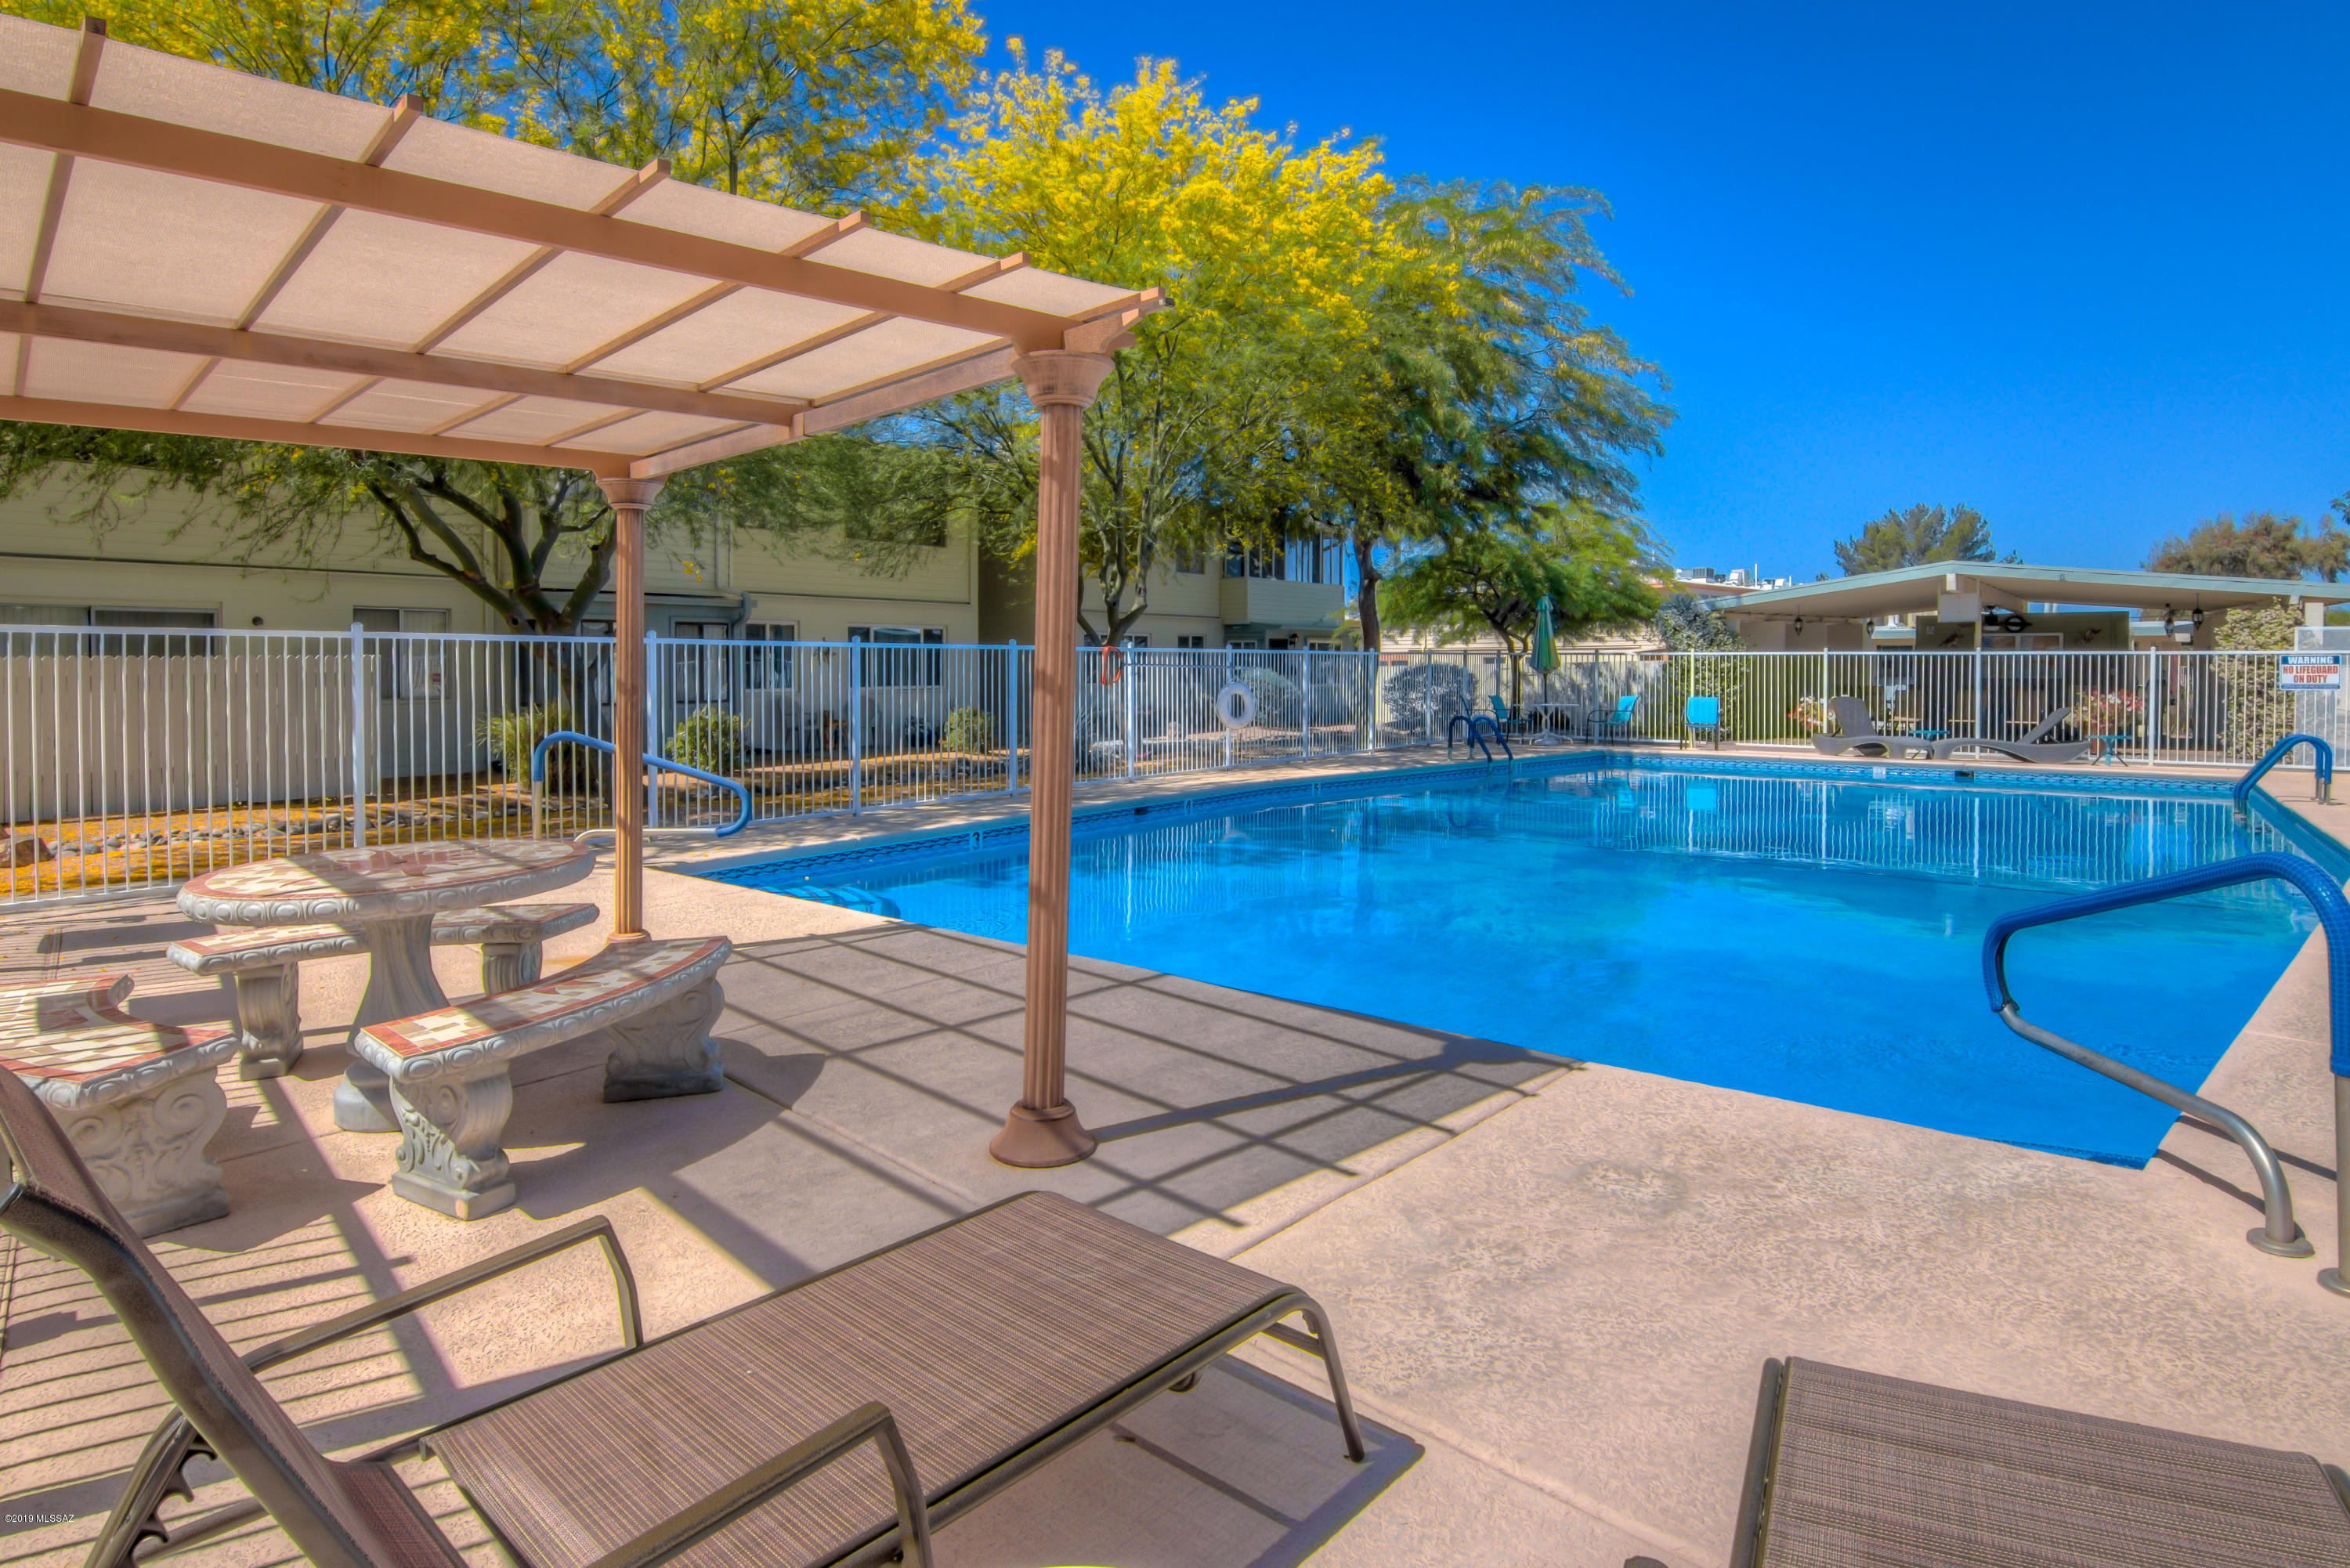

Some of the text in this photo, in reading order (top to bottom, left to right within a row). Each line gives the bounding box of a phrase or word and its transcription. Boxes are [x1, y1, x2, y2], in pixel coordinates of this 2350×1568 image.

[2287, 656, 2334, 665] WARNING
[2283, 665, 2338, 674] NO LIFEGUARD
[2294, 674, 2328, 683] ON DUTY
[972, 831, 980, 850] 3
